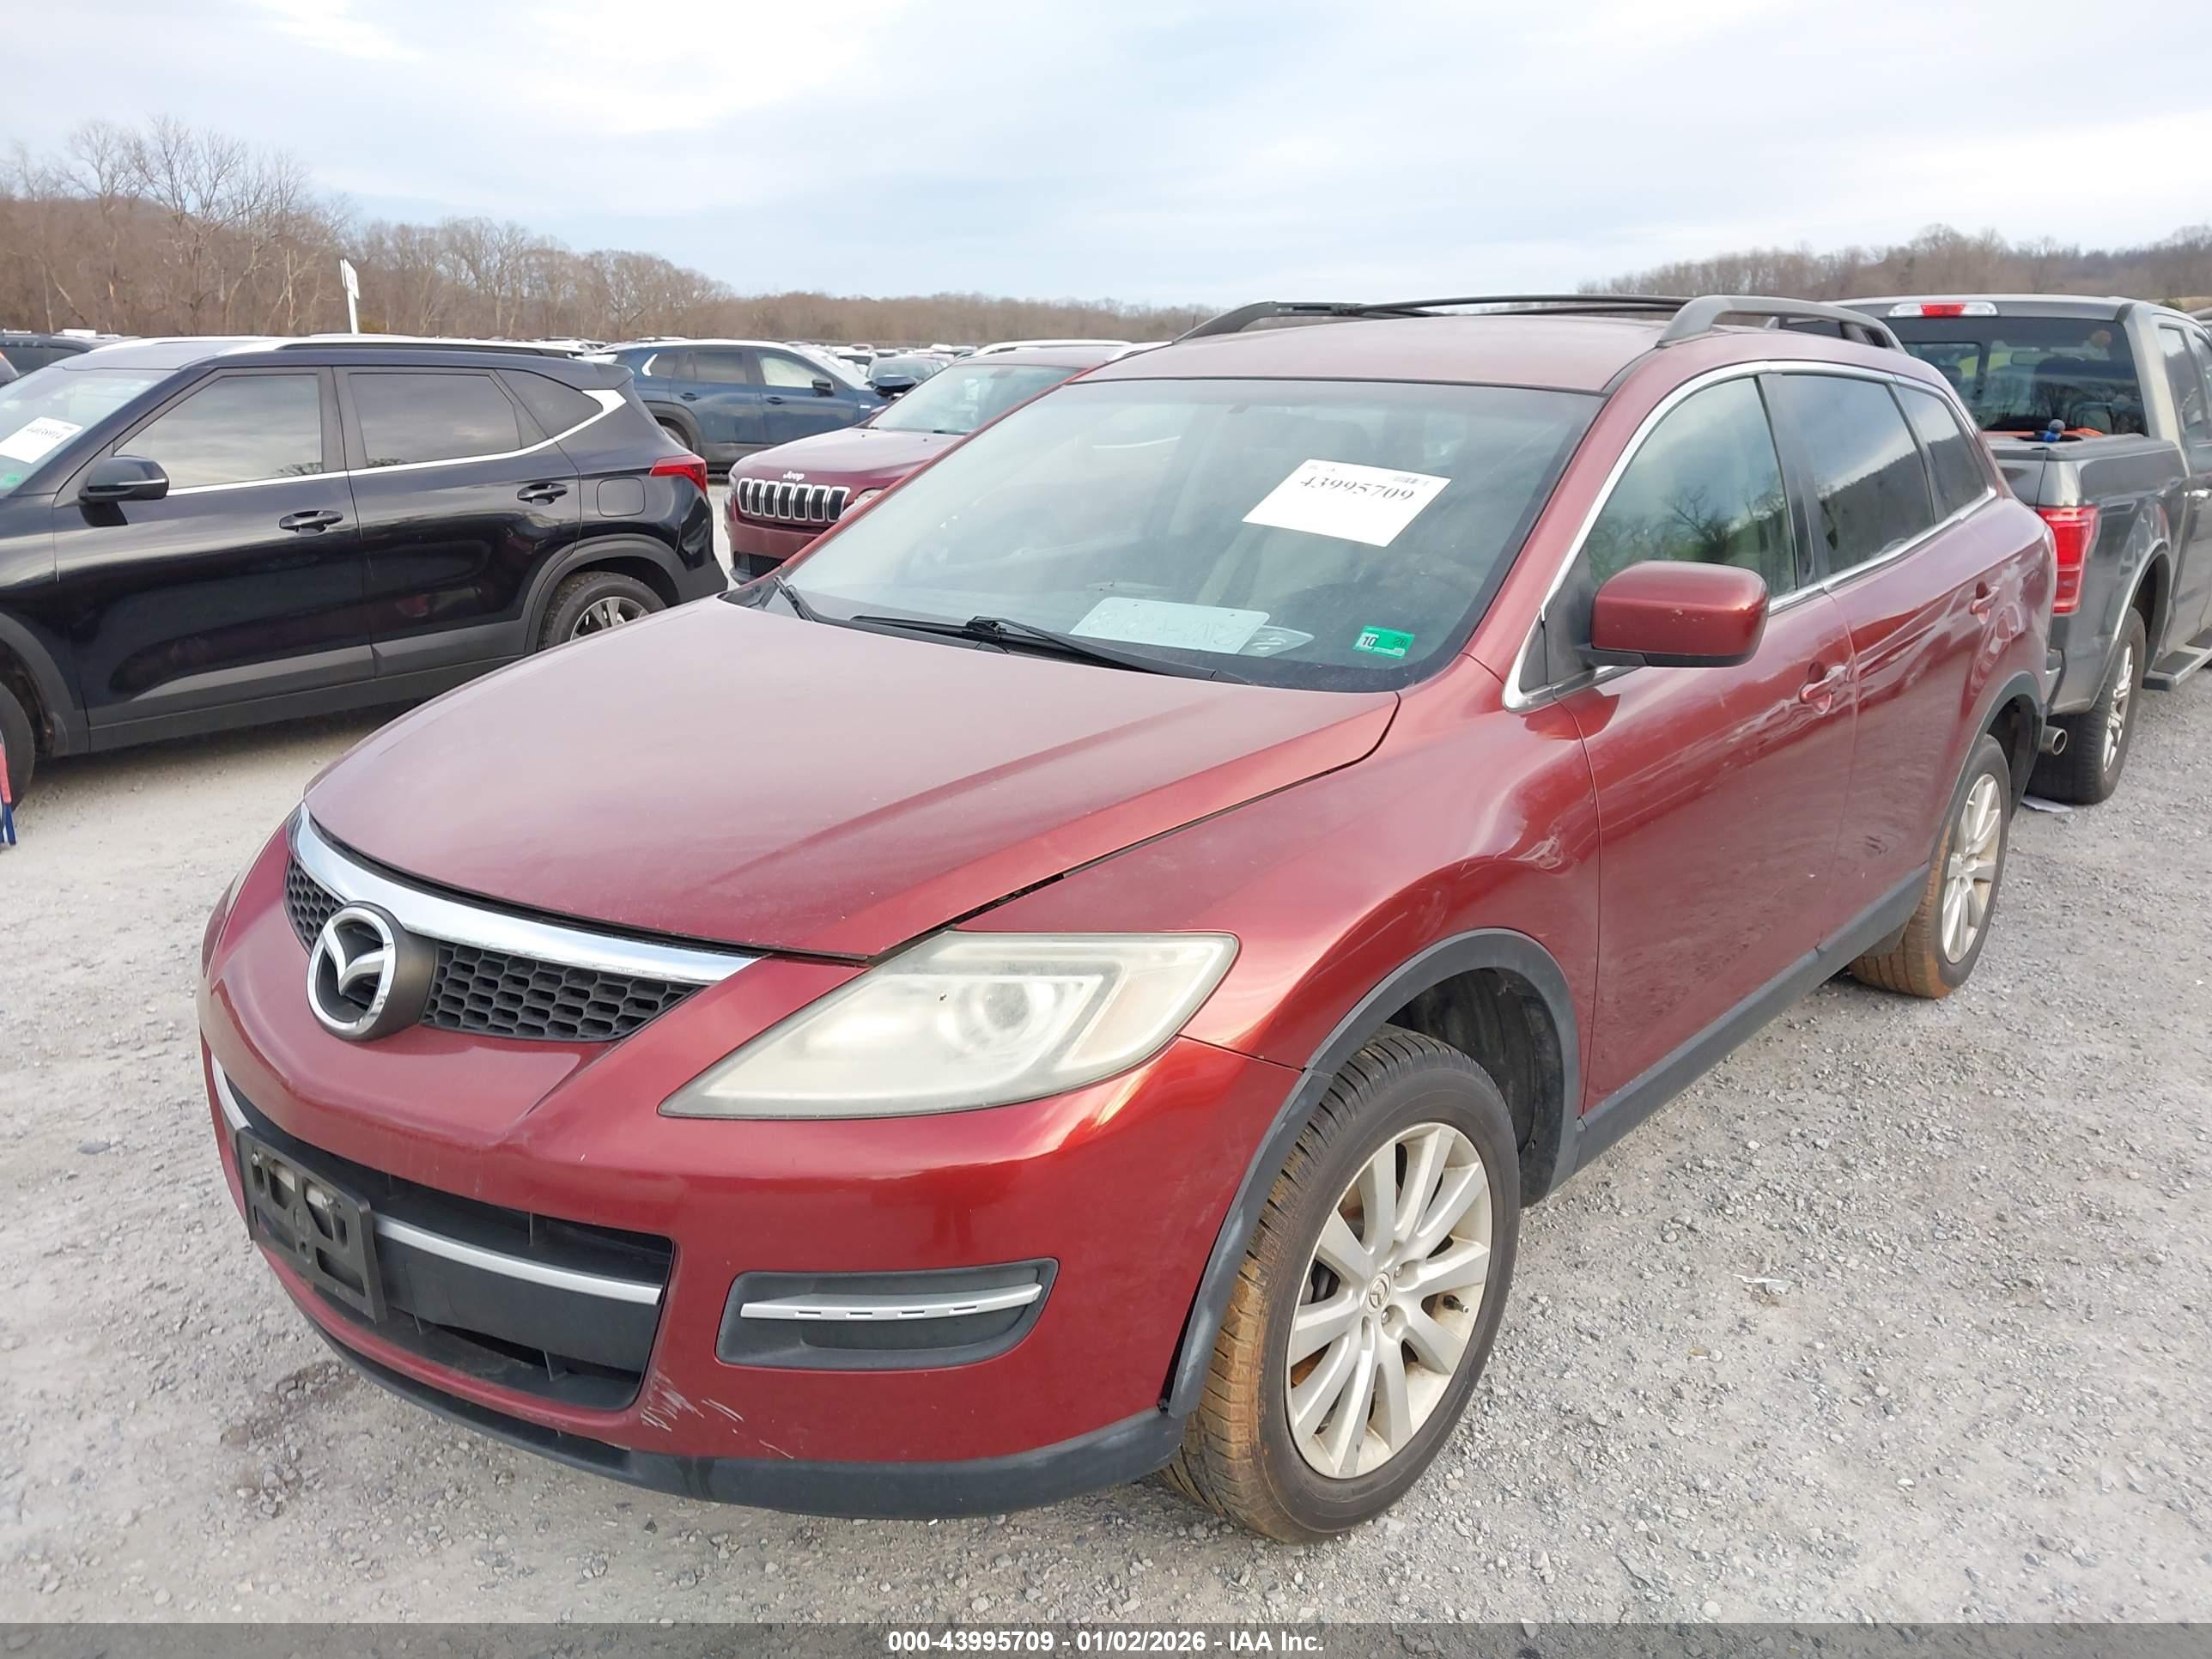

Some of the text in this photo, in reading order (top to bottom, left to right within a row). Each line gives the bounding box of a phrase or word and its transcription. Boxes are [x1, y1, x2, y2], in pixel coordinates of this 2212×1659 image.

[782, 470, 805, 482] Jeep
[1300, 476, 1415, 501] 43995709
[1362, 635, 1377, 647] 10
